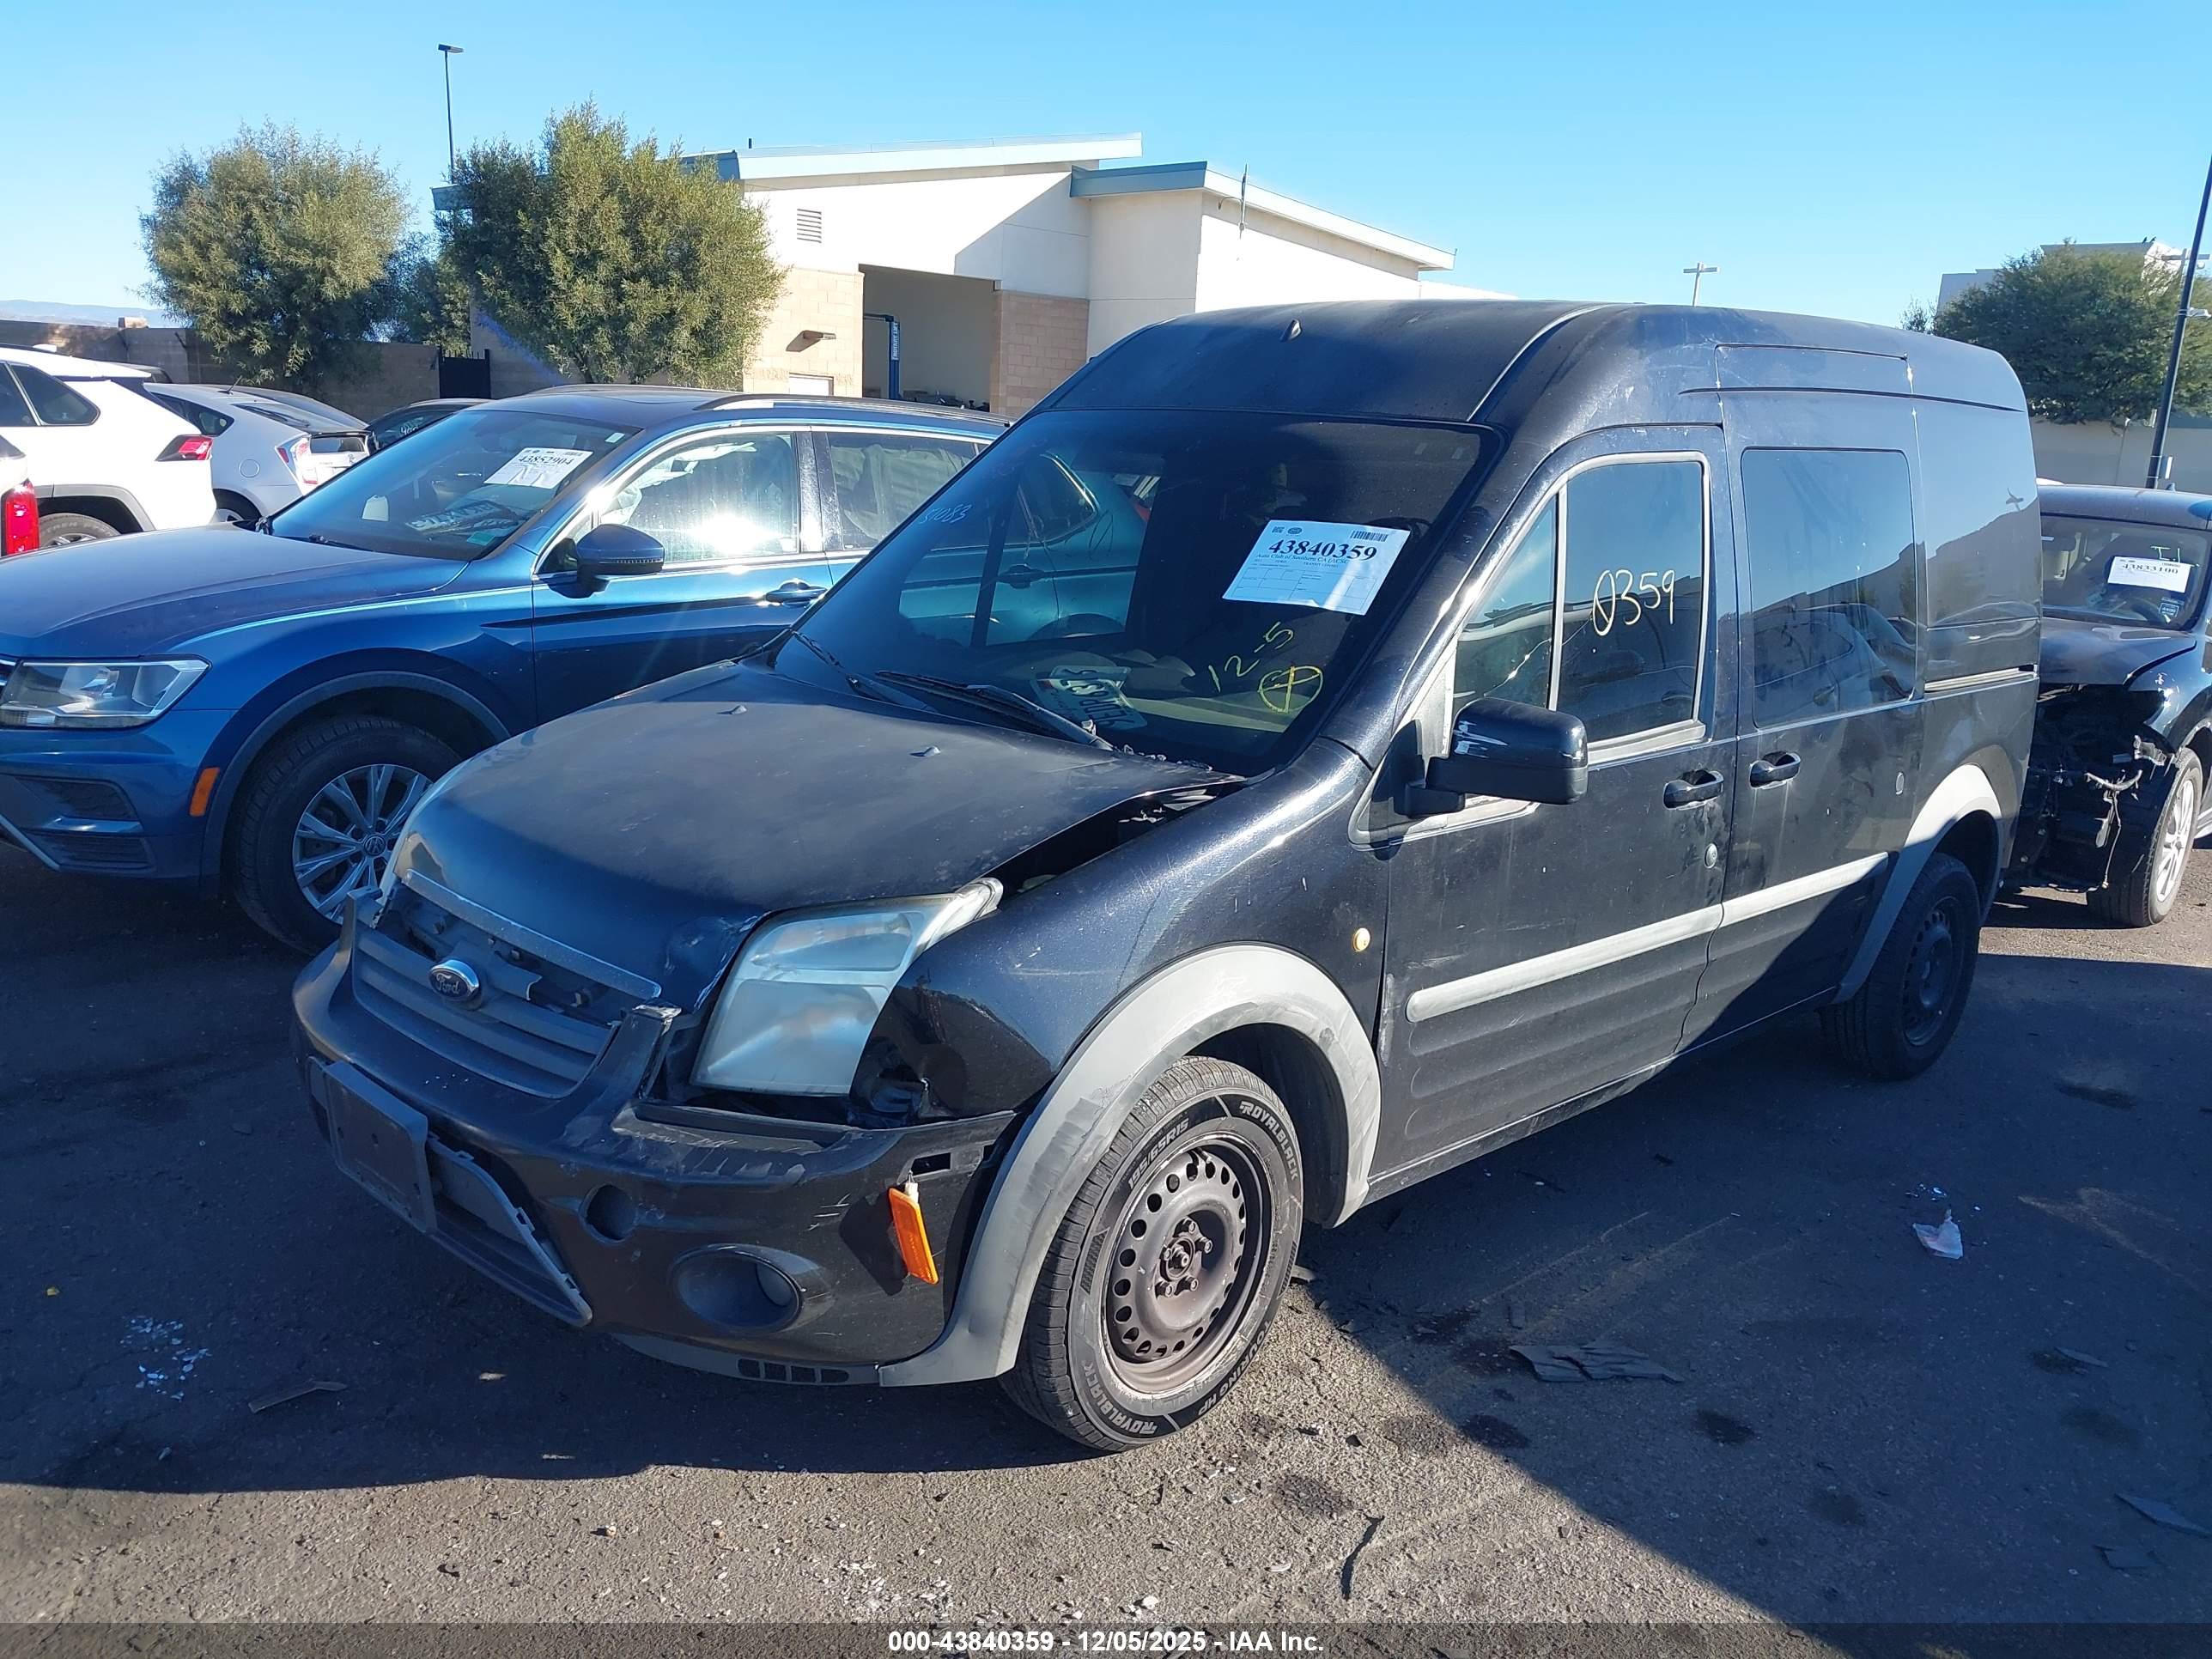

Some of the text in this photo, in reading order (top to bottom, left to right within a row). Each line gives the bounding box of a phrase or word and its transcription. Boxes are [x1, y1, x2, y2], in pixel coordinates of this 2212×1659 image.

[1267, 539, 1378, 561] 43840359
[1592, 569, 1675, 636] 0359
[1207, 622, 1294, 693] 12-5
[436, 973, 460, 994] Ford
[1127, 1117, 1189, 1189] 195/65R15
[1239, 1100, 1299, 1182] ROYALBLACK
[1081, 1359, 1158, 1435] ROYALBLACK
[1198, 1320, 1271, 1416] TOURING HP
